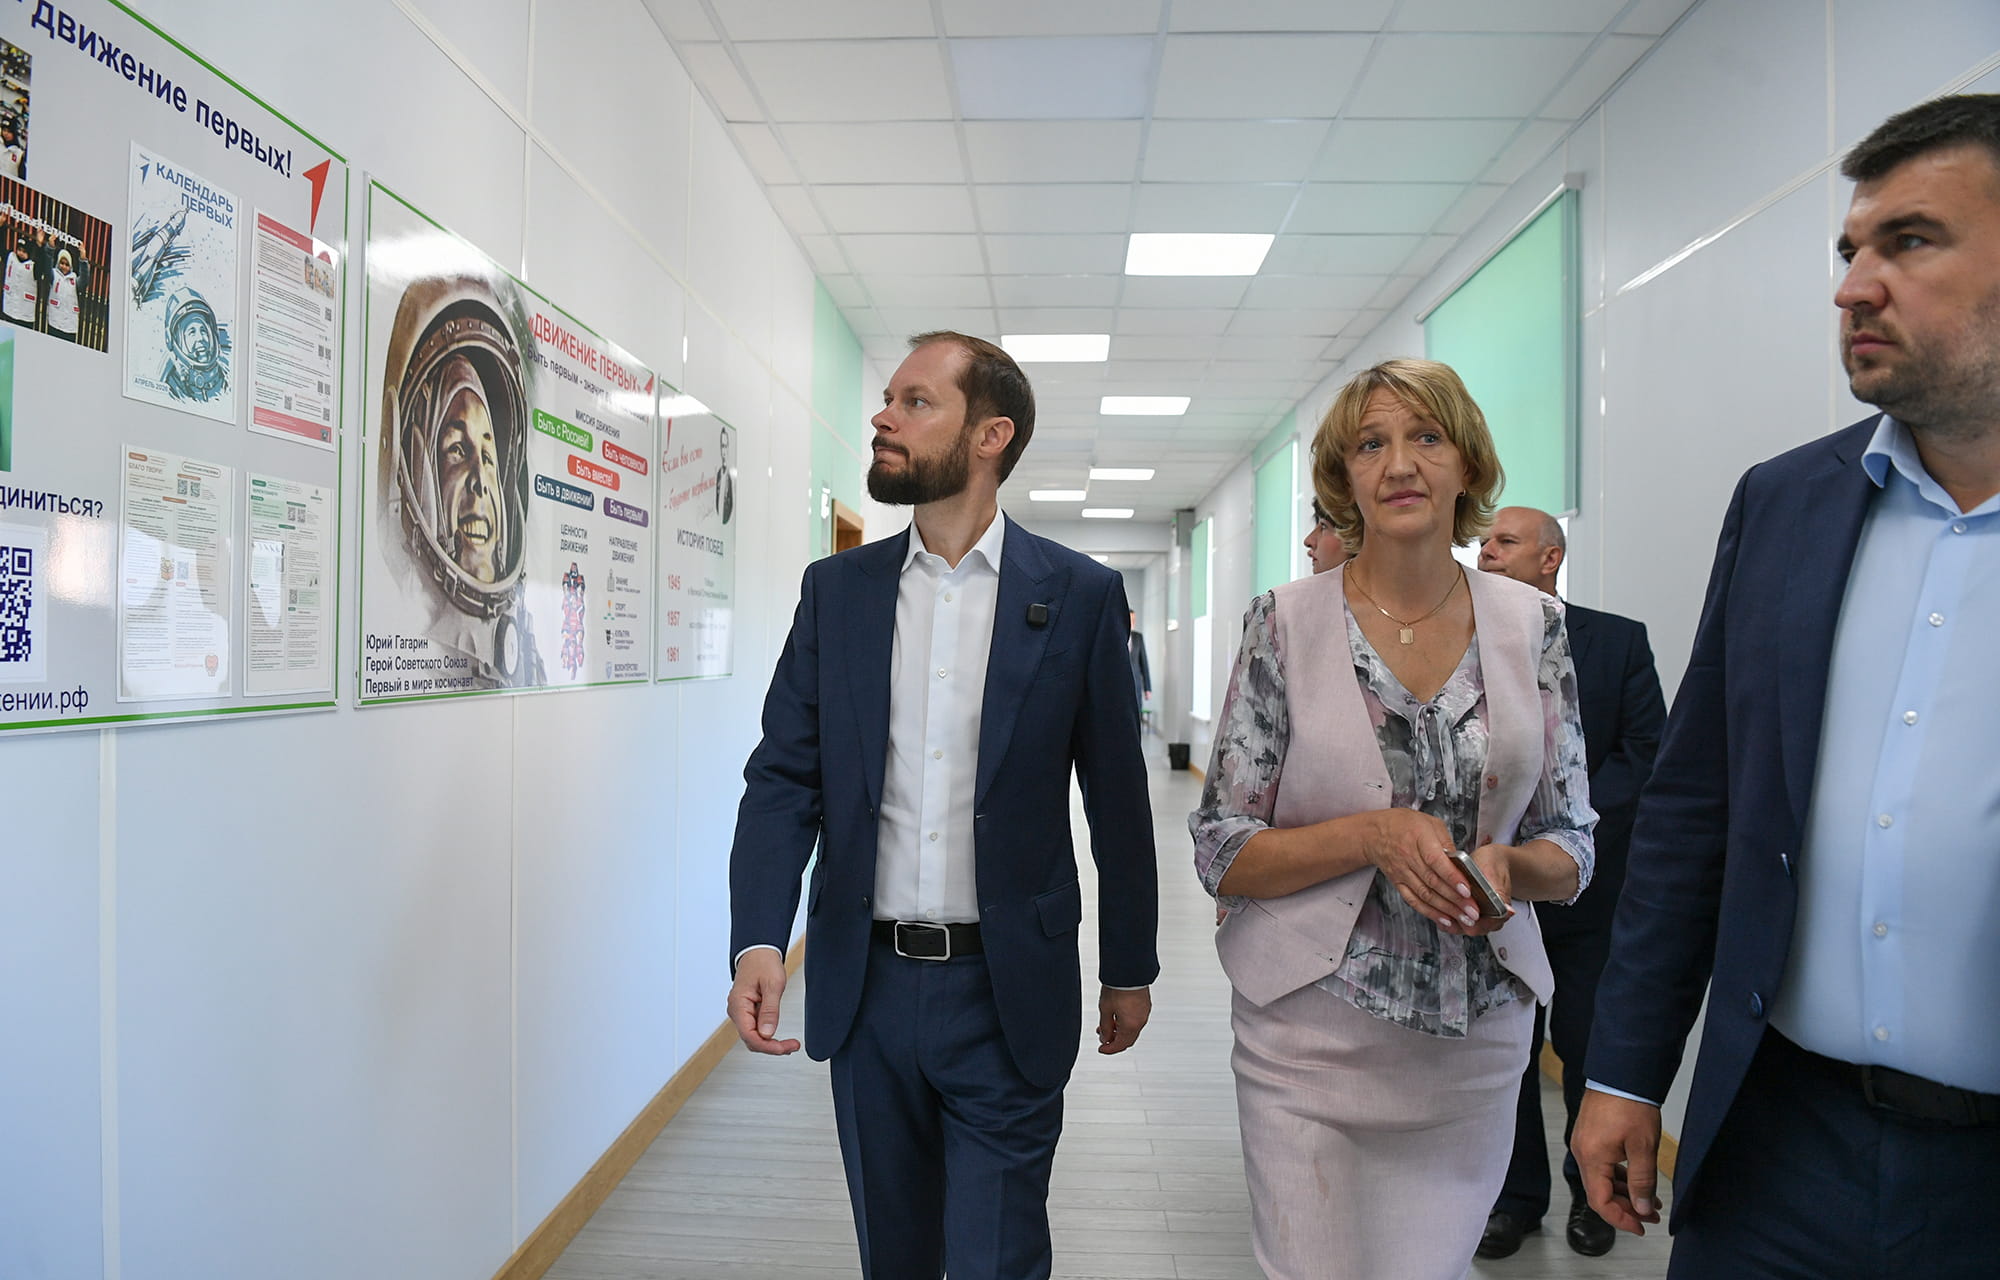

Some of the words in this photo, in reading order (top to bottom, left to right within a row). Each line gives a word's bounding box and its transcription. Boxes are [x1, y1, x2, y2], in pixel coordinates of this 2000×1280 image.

[31, 0, 188, 113] движение
[196, 99, 292, 179] первых!
[156, 161, 234, 213] КАЛЕНДАРЬ
[181, 192, 233, 229] ПЕРВЫХ
[528, 312, 597, 372] «ДВИЖЕНИЕ
[527, 343, 549, 368] Быть
[550, 359, 579, 385] первым
[537, 412, 556, 433] Быть
[556, 424, 561, 434] с
[562, 422, 590, 449] Россией!
[575, 408, 596, 427] МИССИЯ
[595, 418, 621, 439] ДВИЖЕНИЯ
[604, 442, 618, 462] Быть
[575, 459, 592, 479] Быть
[536, 476, 555, 496] Быть
[555, 486, 561, 496] в
[561, 487, 593, 508] движении!
[609, 500, 624, 517] Быть
[560, 524, 588, 539] ЦЕННОСТИ
[677, 528, 705, 551] ИСТОРИЯ
[705, 536, 724, 556] ПОБЕД
[560, 539, 589, 554] ДВИЖЕНИЯ
[667, 574, 681, 591] 1945
[366, 634, 393, 653] Юрий
[394, 635, 429, 653] Гагарин
[365, 656, 393, 675] Герой
[394, 656, 441, 671] Советского
[443, 655, 468, 669] Союза
[0, 684, 89, 715] ении.рф
[365, 678, 402, 696] Первый
[404, 681, 410, 691] в
[411, 680, 433, 694] мире
[434, 676, 474, 690] космонавт
